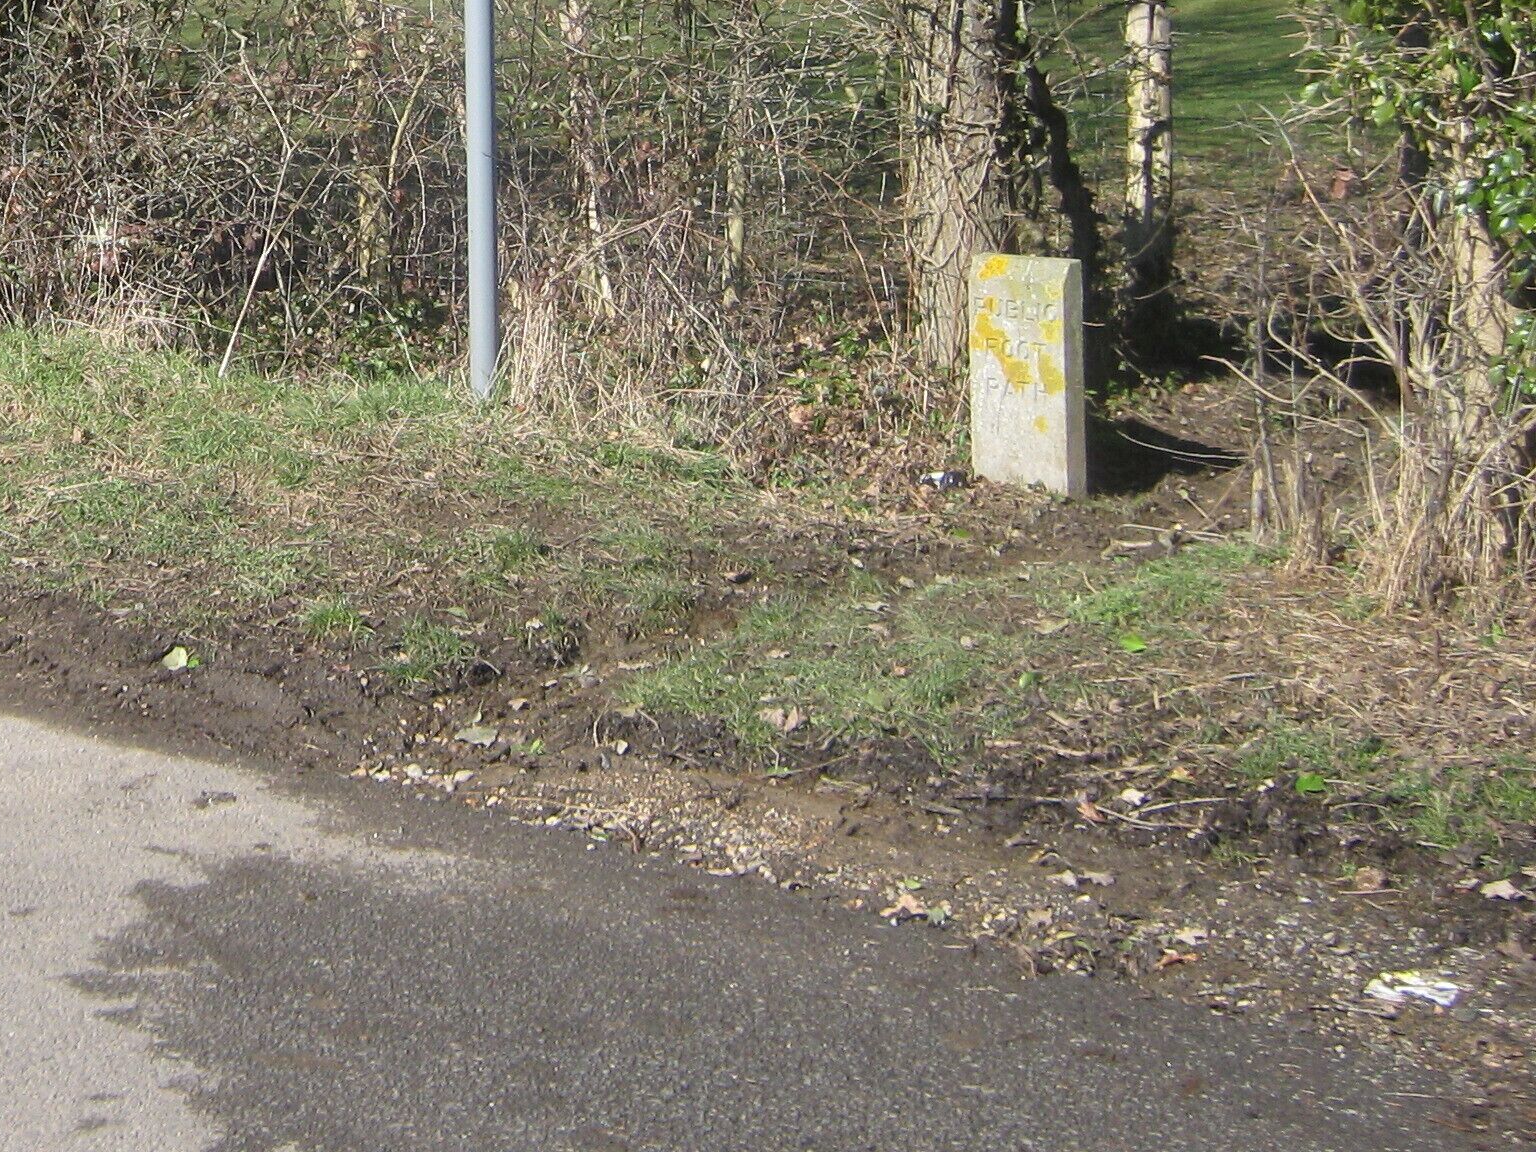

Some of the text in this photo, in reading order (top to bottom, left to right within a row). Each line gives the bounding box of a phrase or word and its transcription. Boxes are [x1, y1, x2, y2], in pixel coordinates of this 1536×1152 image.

[973, 297, 1058, 322] PUBLIC
[985, 337, 1047, 360] FOOT
[985, 377, 1050, 401] PATH
